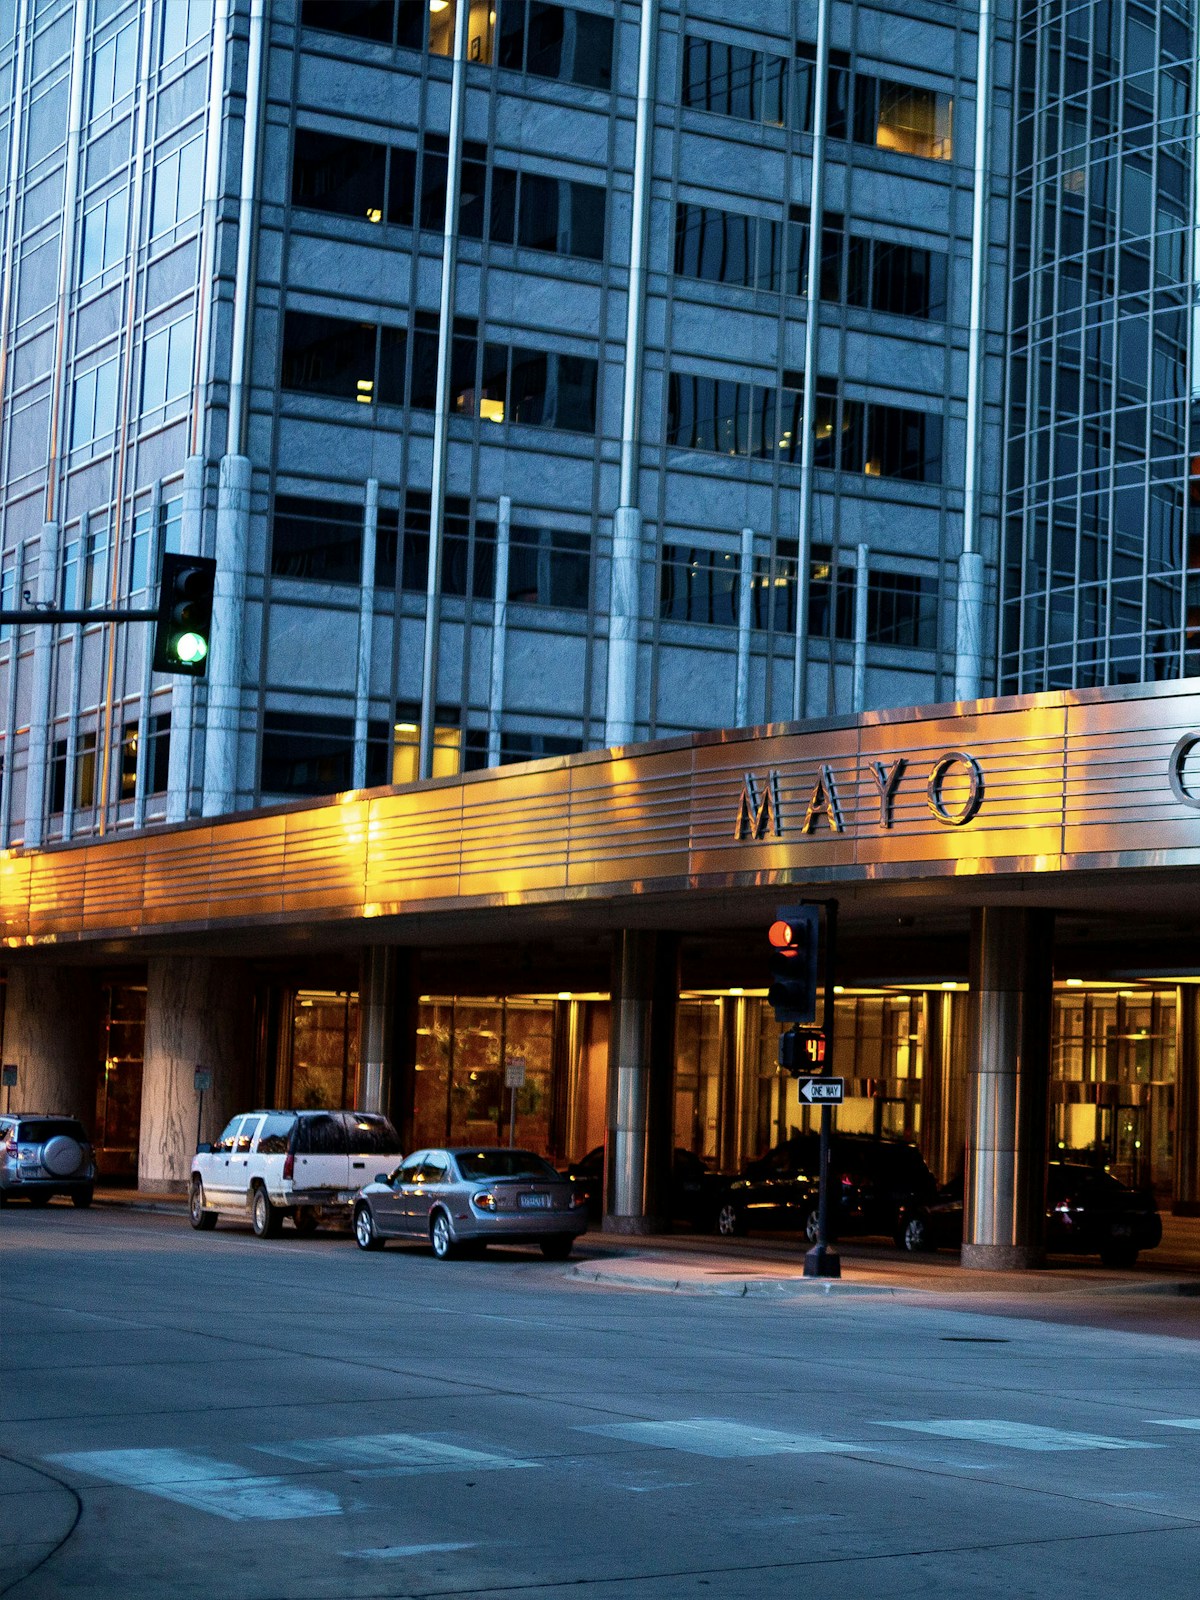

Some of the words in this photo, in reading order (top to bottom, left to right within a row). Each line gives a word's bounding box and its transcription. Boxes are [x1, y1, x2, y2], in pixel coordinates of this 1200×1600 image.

[734, 752, 985, 840] MAYO
[811, 1086, 822, 1096] ONE
[826, 1086, 838, 1096] WAY
